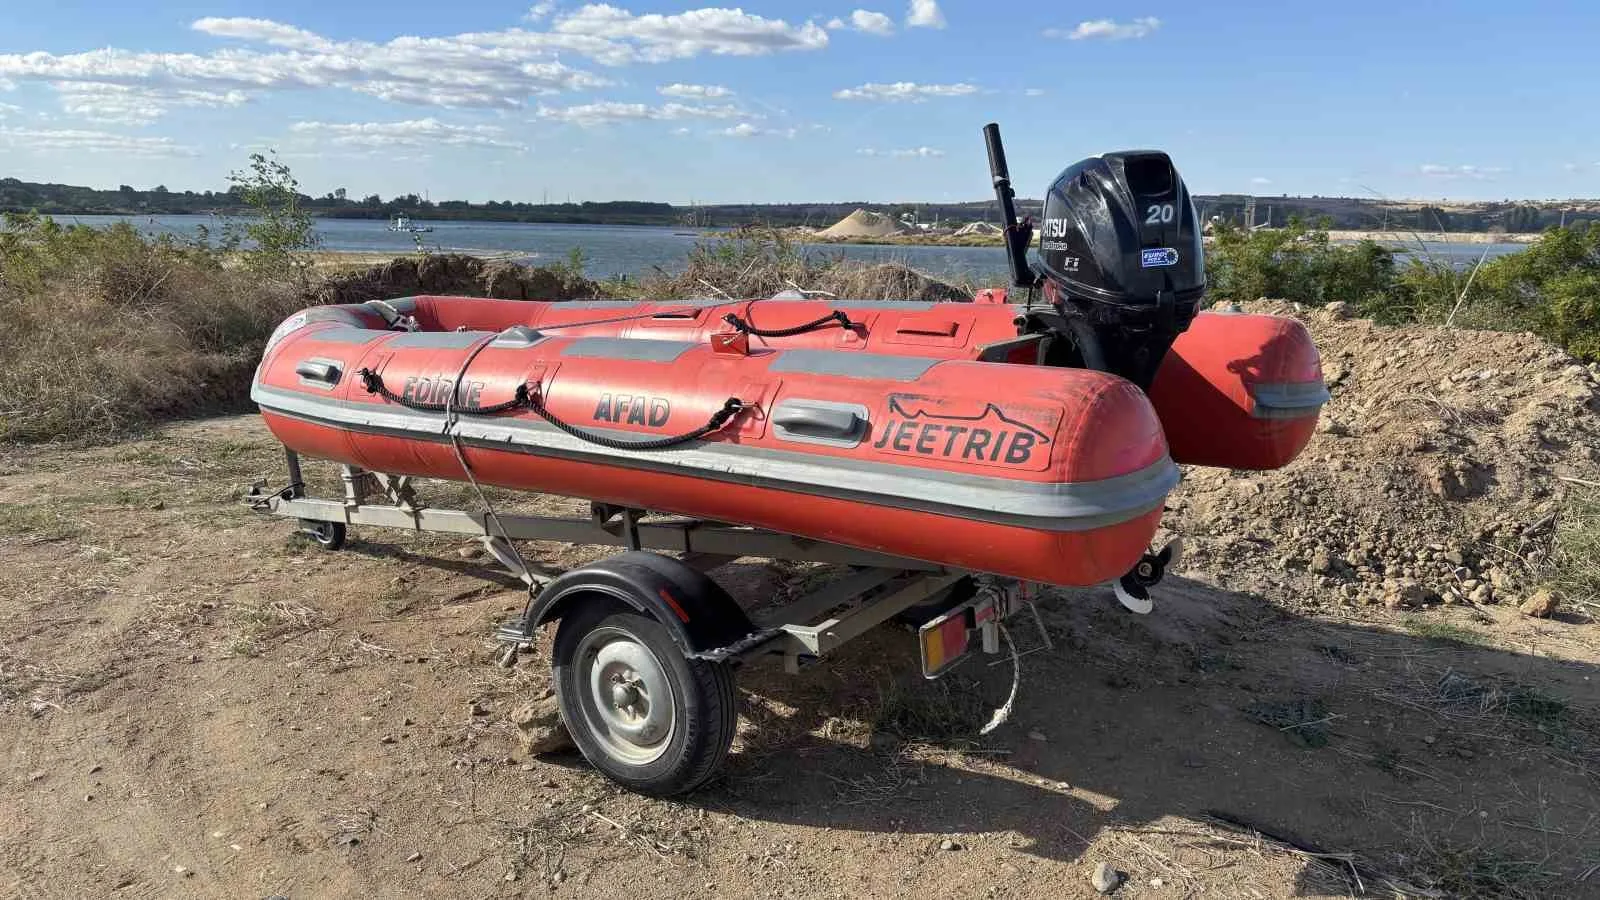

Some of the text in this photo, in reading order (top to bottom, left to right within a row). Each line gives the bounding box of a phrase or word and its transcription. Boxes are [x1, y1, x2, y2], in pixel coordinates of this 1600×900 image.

[1145, 204, 1174, 224] 20
[593, 392, 671, 427] AFAD
[874, 420, 1036, 464] JEETRIB
